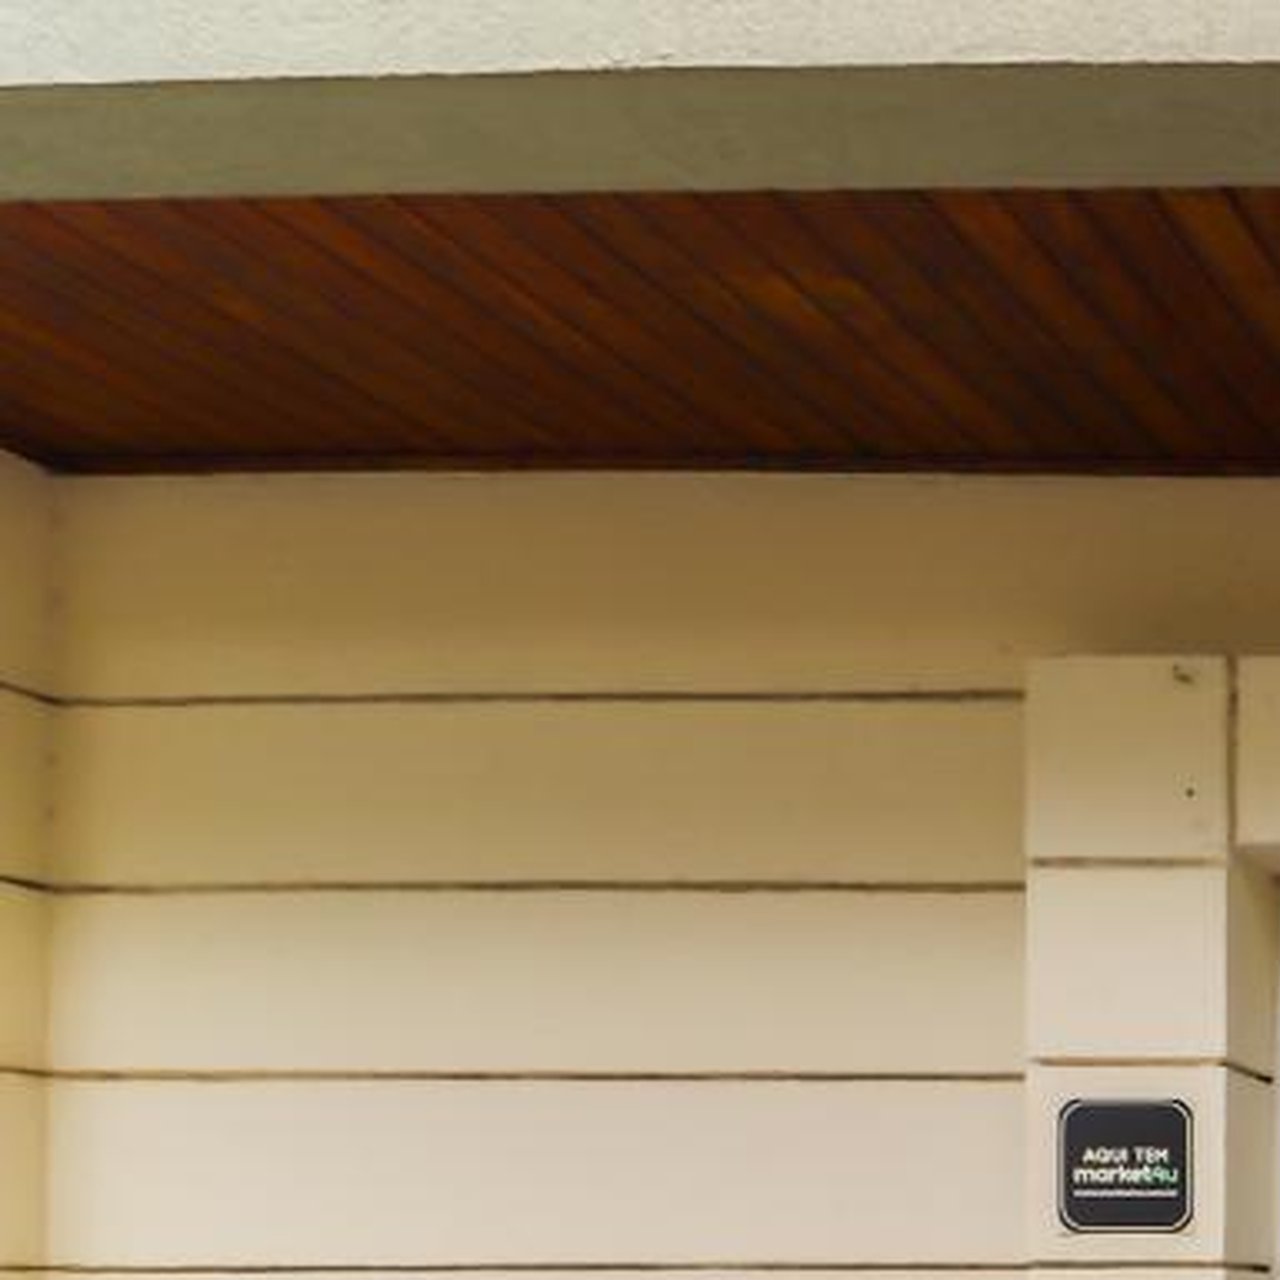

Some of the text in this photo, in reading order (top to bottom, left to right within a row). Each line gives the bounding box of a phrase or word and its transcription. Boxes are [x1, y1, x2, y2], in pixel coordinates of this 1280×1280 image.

[1082, 1146, 1169, 1164] AQUI TEM
[1072, 1165, 1178, 1184] market4u
